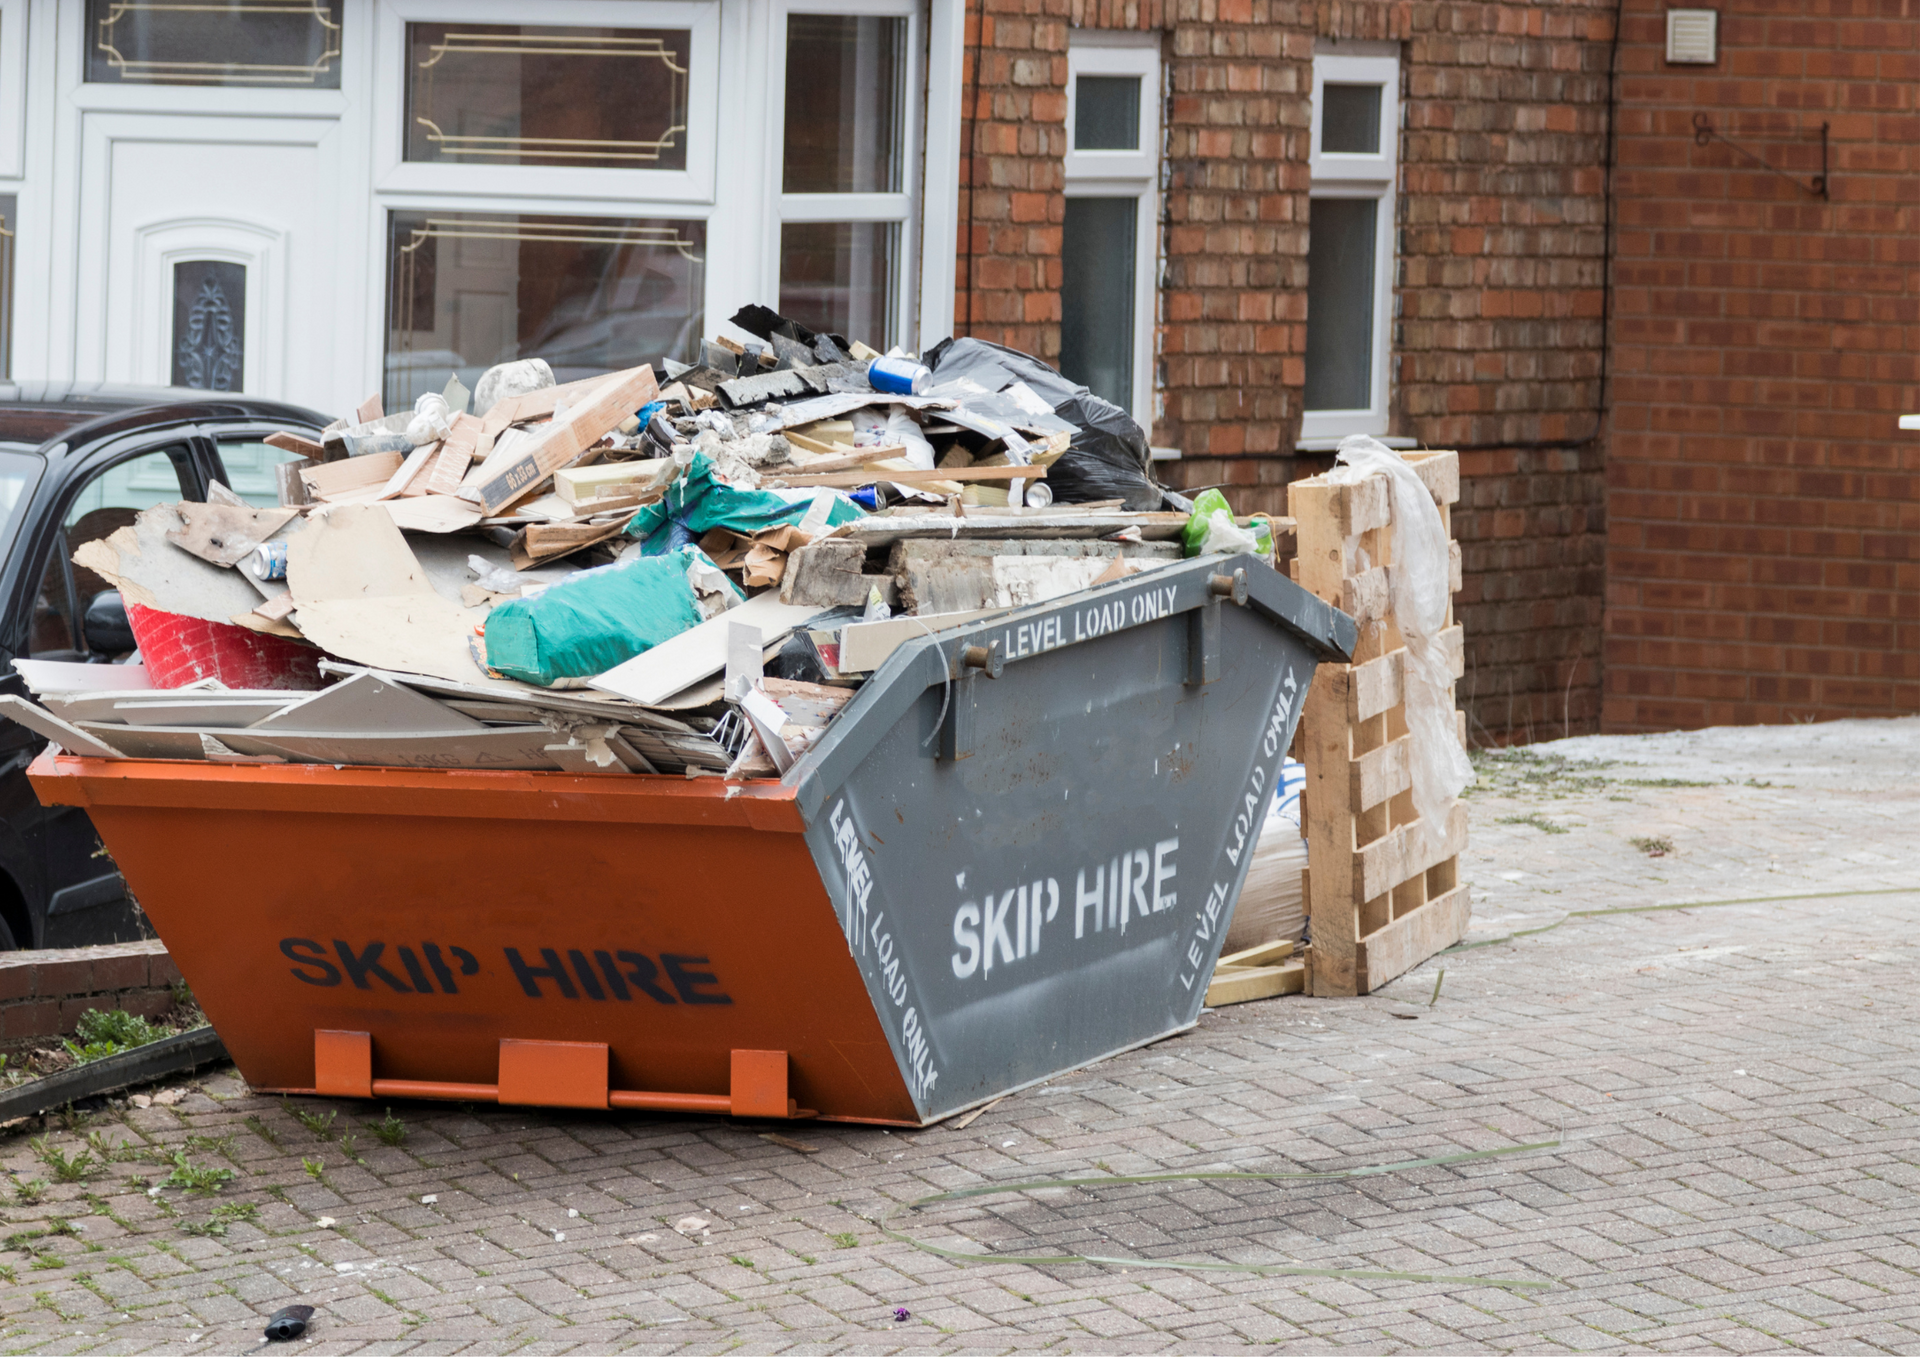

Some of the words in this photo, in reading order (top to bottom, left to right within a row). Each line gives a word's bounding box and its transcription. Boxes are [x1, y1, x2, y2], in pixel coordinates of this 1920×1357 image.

[1005, 615, 1066, 659] LEVEL
[1074, 600, 1126, 642] LOAD
[1131, 585, 1177, 624] ONLY
[1180, 881, 1229, 991] LEVEL
[1226, 766, 1265, 866] LOAD
[1264, 666, 1297, 758] ONLY
[279, 936, 480, 995] SKIP
[503, 946, 735, 1005] HIRE
[829, 798, 874, 916] LEVEL
[870, 911, 908, 1006] LOAD
[903, 1006, 938, 1091] ONLY
[951, 877, 1060, 979] SKIP
[1074, 836, 1179, 939] HIRE
